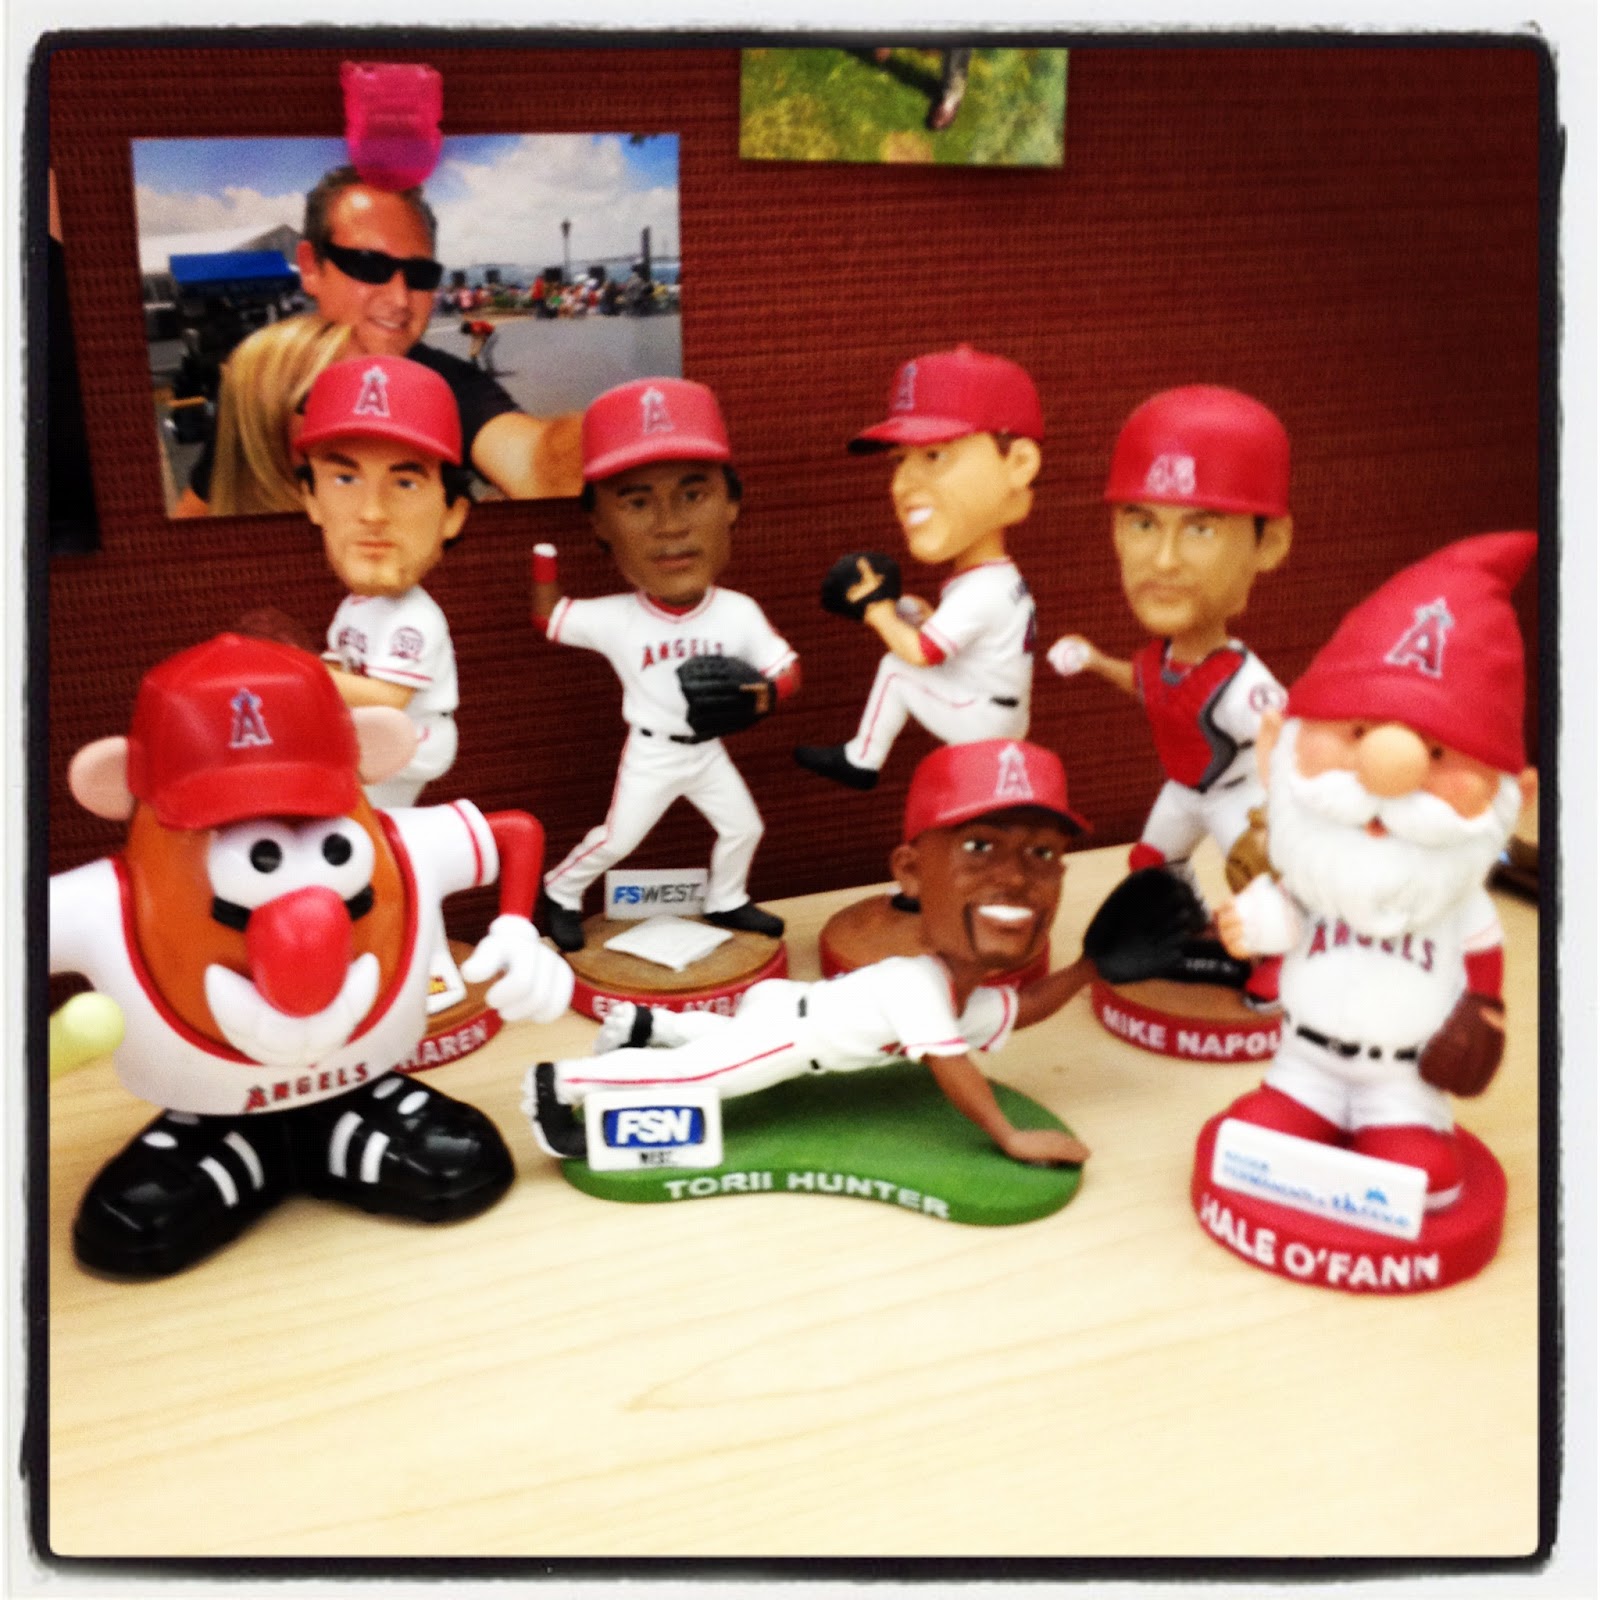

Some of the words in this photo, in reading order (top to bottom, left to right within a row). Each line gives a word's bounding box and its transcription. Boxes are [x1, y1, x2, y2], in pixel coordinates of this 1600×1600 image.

[353, 366, 391, 418] A
[641, 386, 675, 435] A
[641, 638, 725, 671] ANGELS
[1384, 597, 1454, 679] A
[229, 688, 274, 749] A
[995, 741, 1034, 800] A
[1102, 1004, 1167, 1050] MIKE
[1176, 1030, 1281, 1058] NAPOL
[243, 1061, 369, 1112] ANGELS
[616, 1108, 694, 1145] FSN
[664, 1171, 773, 1200] TORII
[786, 1171, 950, 1219] HUNTER
[1200, 1193, 1276, 1266] HALE
[1283, 1242, 1440, 1288] O'FANN
